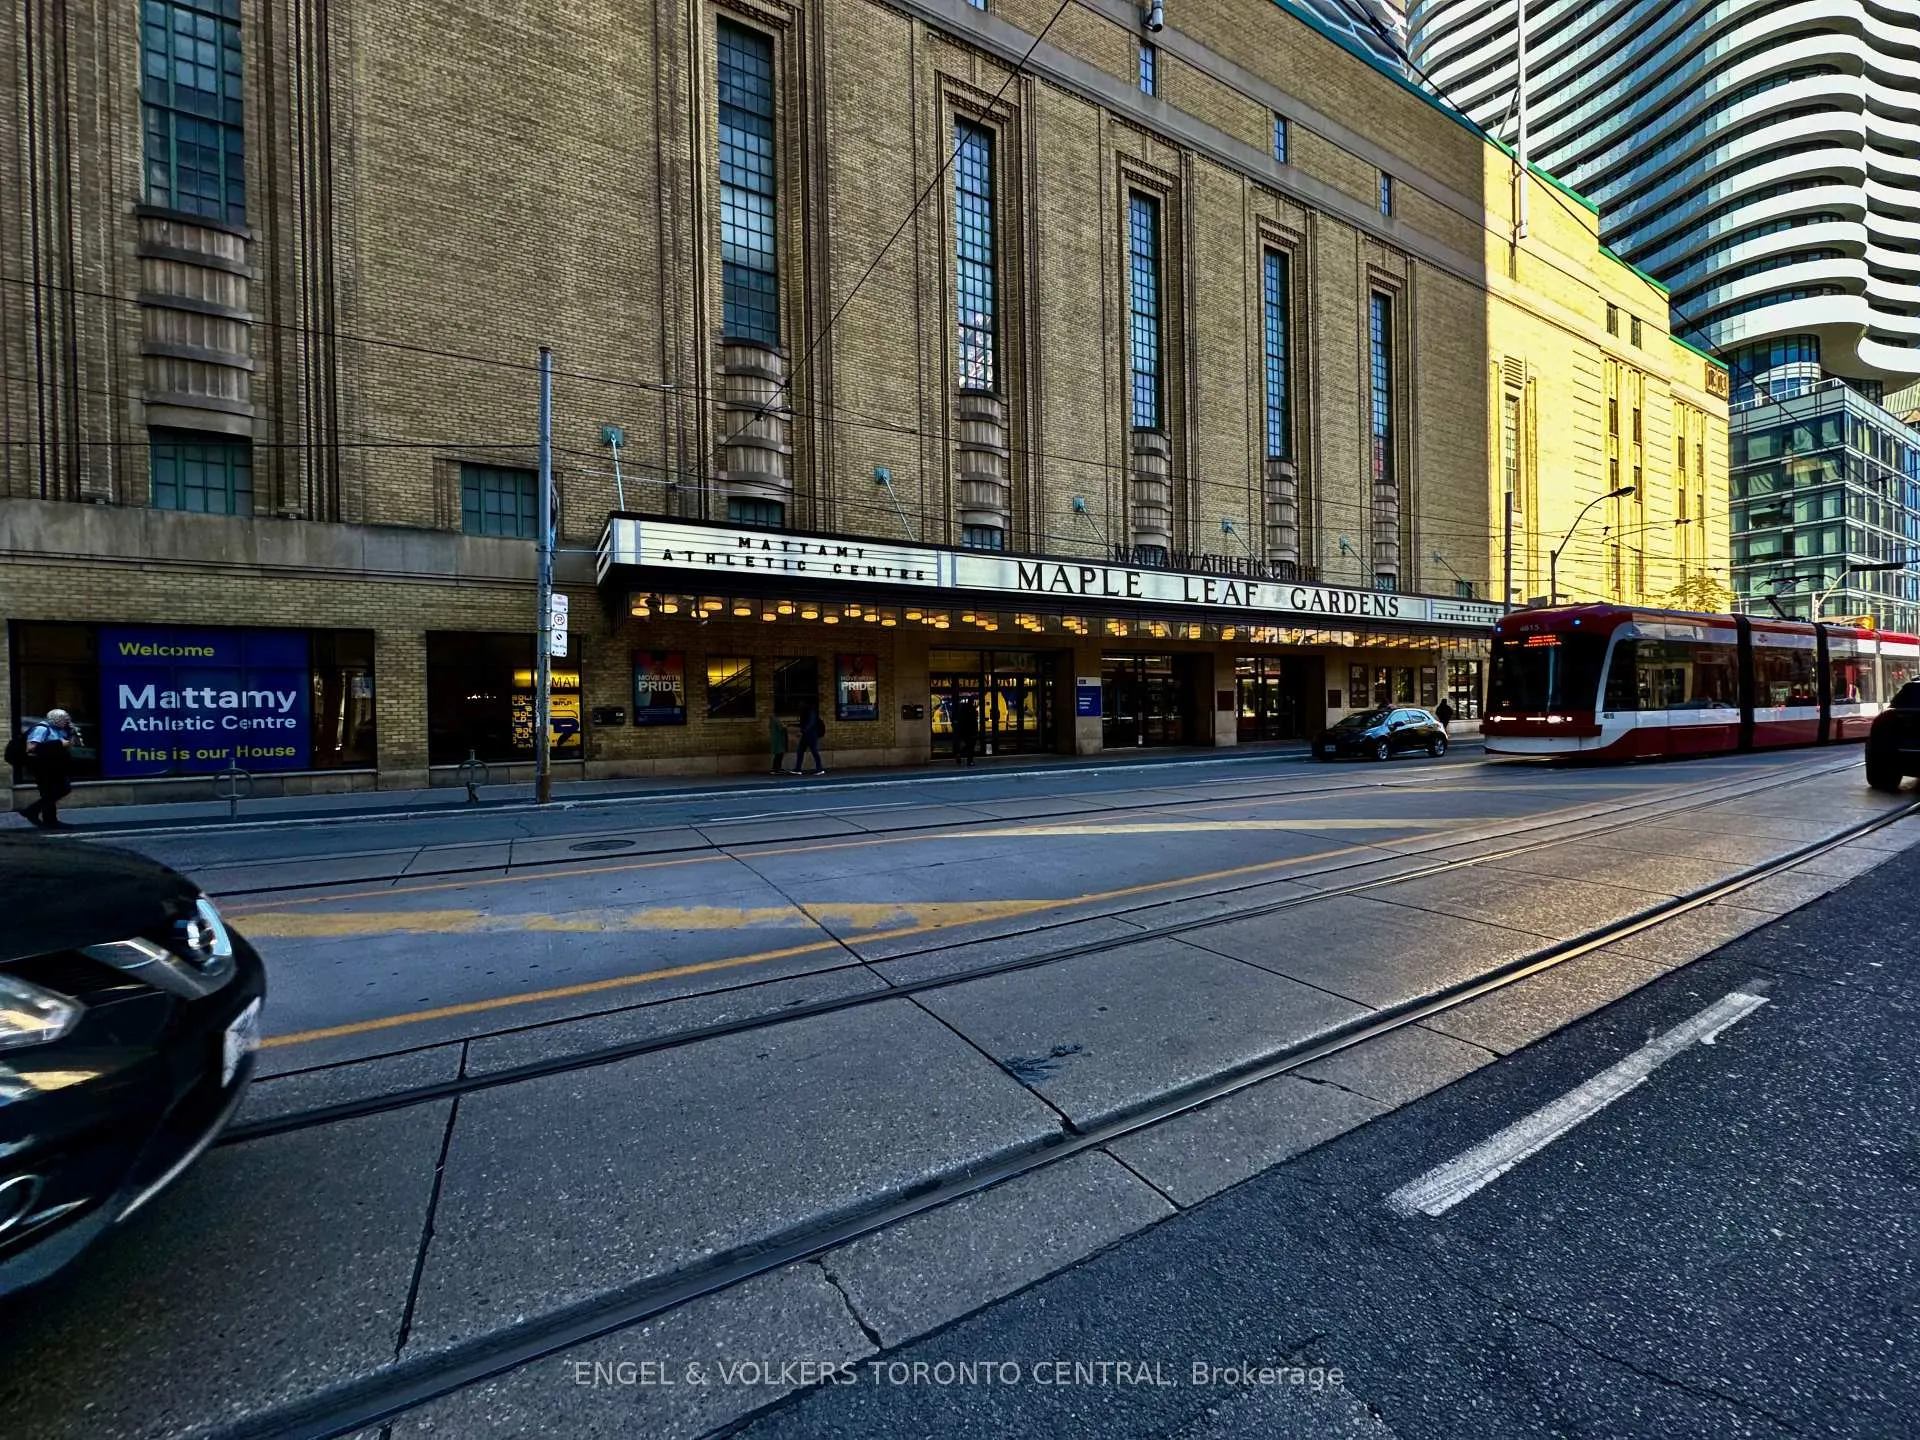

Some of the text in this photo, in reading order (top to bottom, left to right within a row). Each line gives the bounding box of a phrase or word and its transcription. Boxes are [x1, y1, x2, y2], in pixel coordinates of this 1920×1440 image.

[738, 536, 866, 559] MATTAMY
[663, 549, 925, 581] ATHLETIC CENTRE
[1114, 543, 1195, 570] MATTAMY
[1201, 553, 1266, 577] ATHLETIC
[1017, 560, 1399, 617] MAPLE LEAF GARDENS
[118, 641, 215, 657] Welcome
[638, 681, 681, 692] PRIDE
[841, 681, 877, 691] PRIDE
[118, 684, 297, 713] Mattamy
[120, 715, 297, 732] Athletic Centre
[121, 745, 297, 762] This is our House
